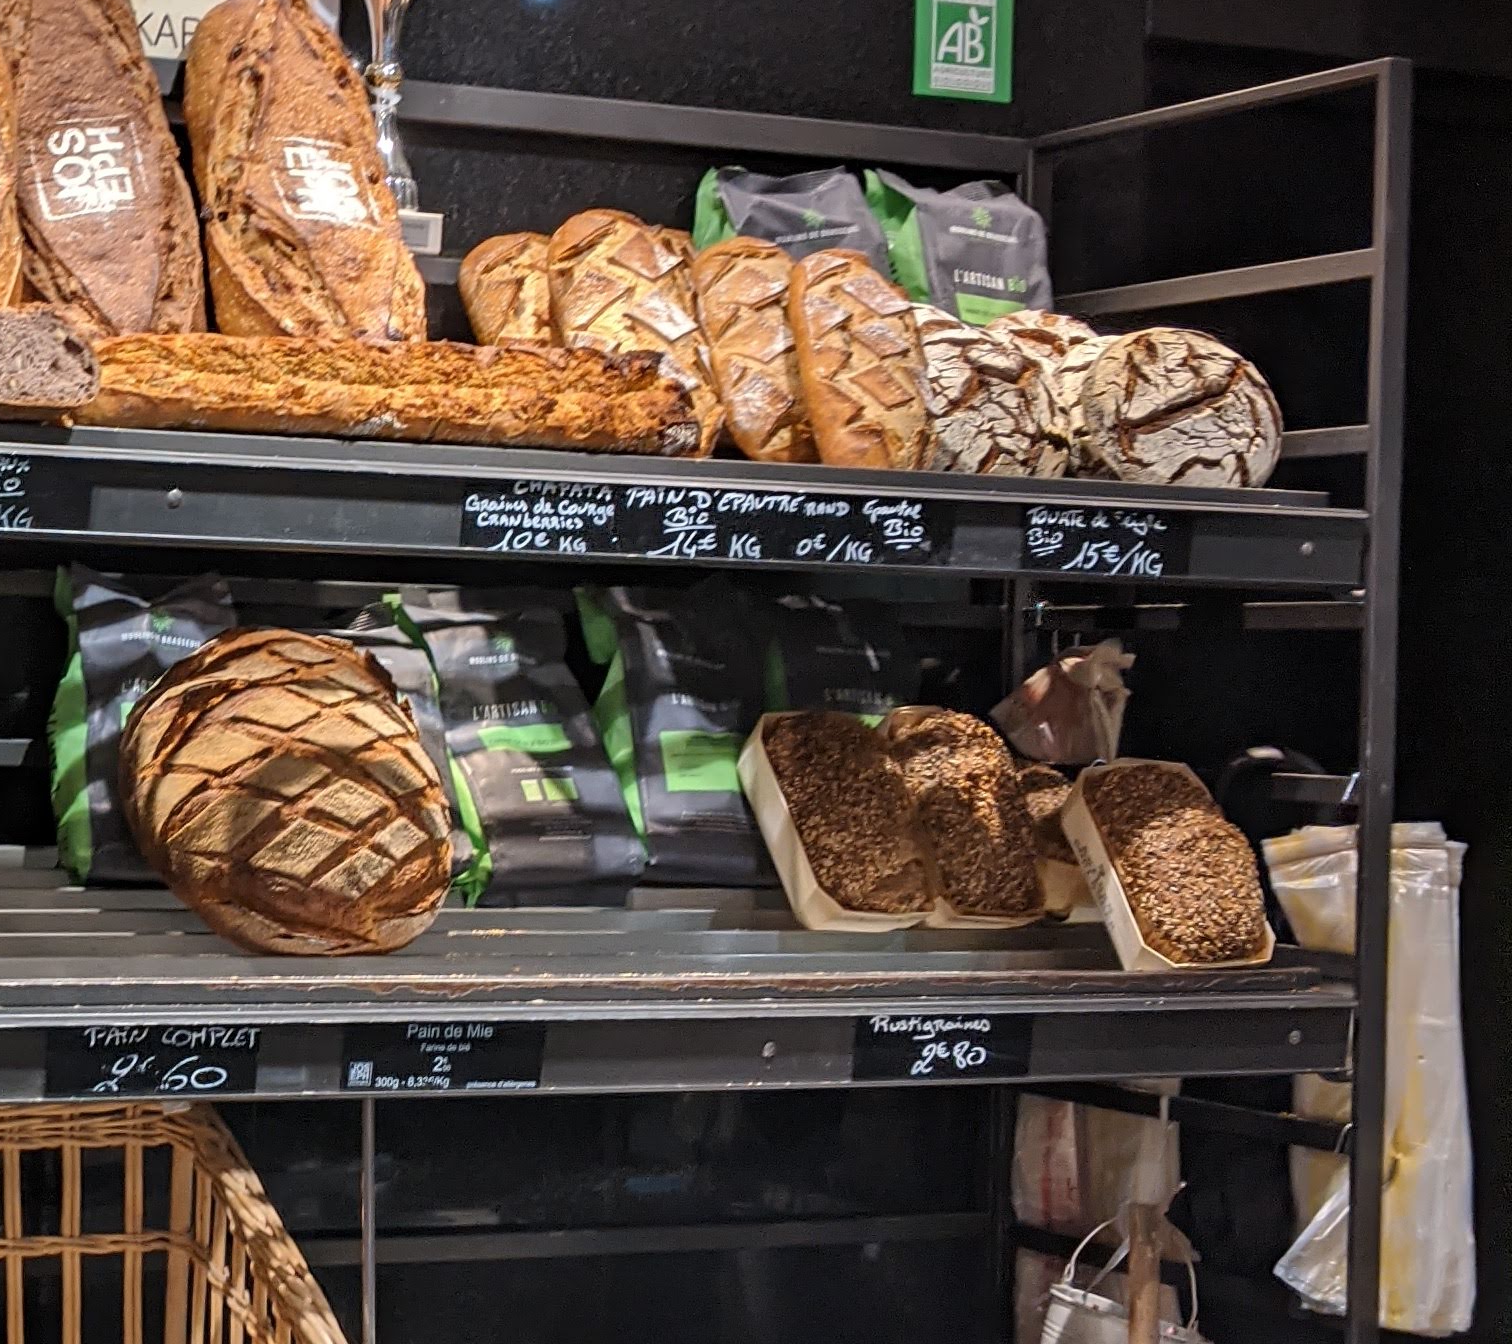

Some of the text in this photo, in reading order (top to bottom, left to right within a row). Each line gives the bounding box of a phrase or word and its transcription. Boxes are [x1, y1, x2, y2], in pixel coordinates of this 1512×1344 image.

[937, 21, 985, 64] AB
[804, 502, 851, 517] RAND
[884, 518, 925, 538] Bio
[1026, 527, 1065, 546] Bio
[729, 533, 762, 559] KG
[84, 1026, 261, 1049] PAIN COMPLET
[406, 1023, 494, 1039] Pain de Mie
